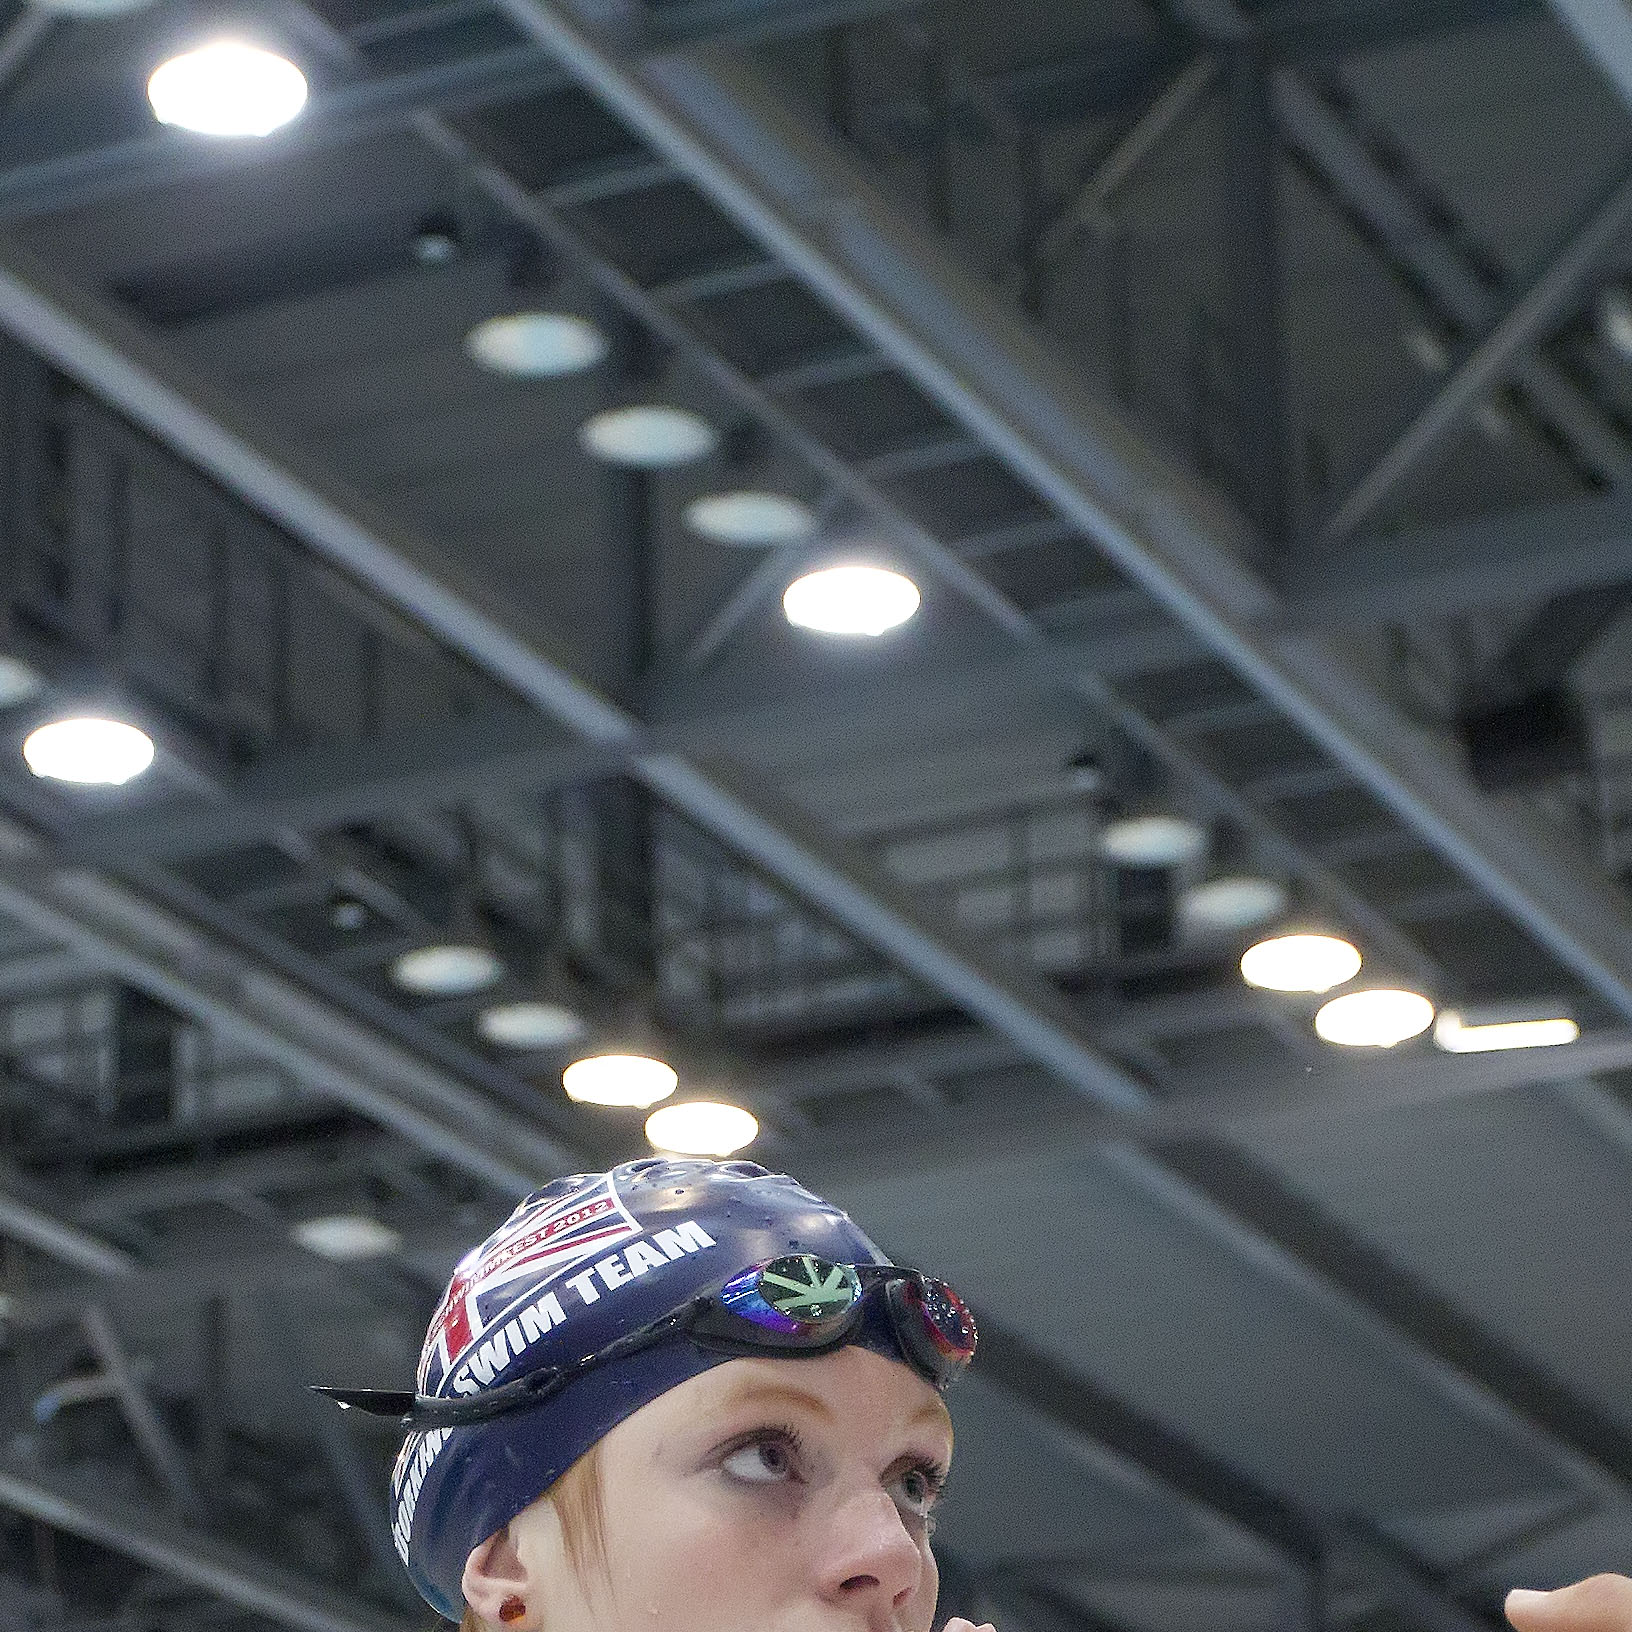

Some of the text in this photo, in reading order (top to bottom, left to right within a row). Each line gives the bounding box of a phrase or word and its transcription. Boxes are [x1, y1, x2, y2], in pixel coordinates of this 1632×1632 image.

[552, 1199, 610, 1236] 2012
[392, 1220, 717, 1567] DORKIN SWIM TEAM
